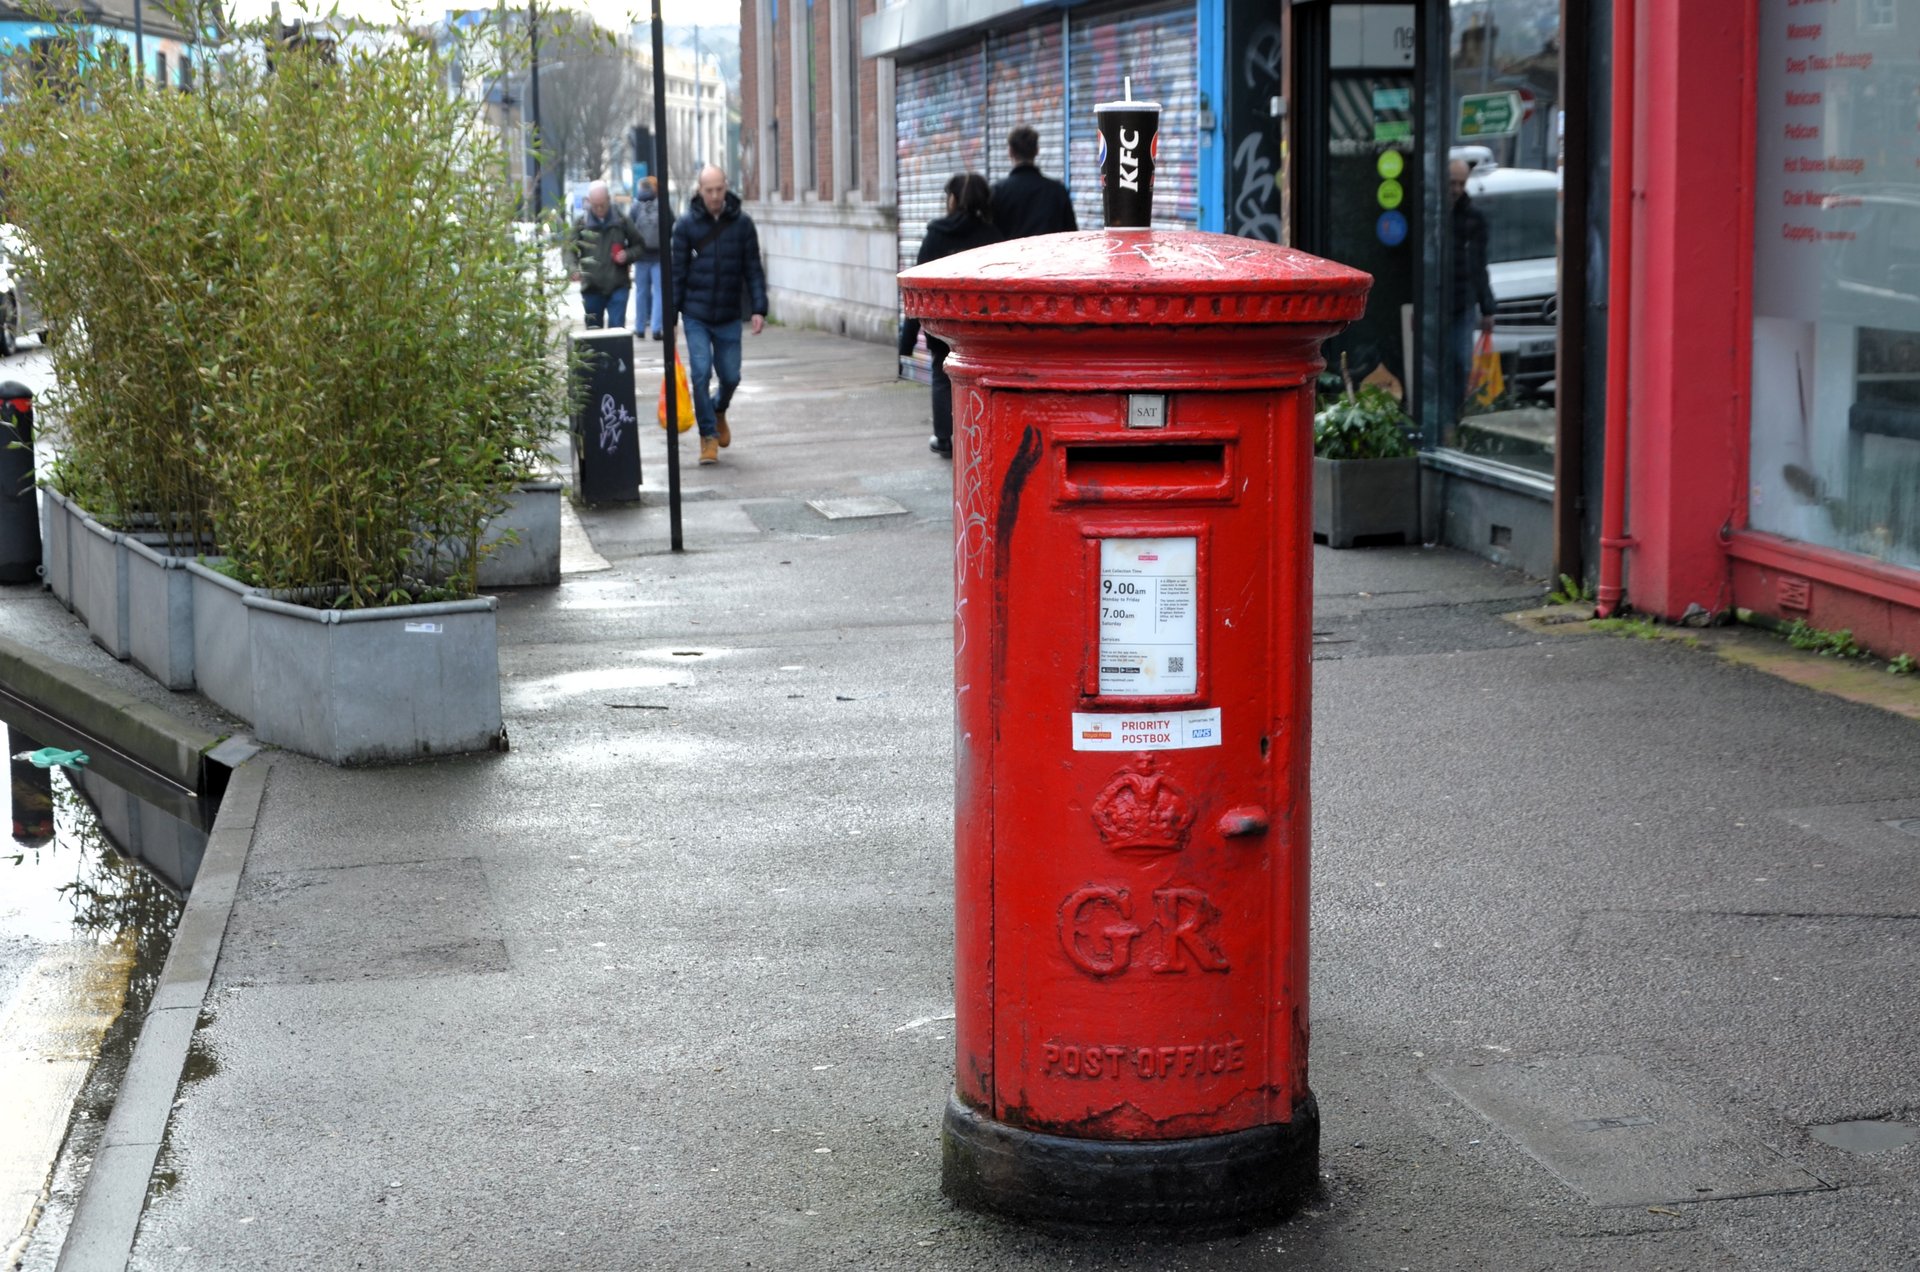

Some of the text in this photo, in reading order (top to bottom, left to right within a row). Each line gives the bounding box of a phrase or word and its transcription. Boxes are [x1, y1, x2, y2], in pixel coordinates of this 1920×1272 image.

[1119, 129, 1139, 192] KFC
[1137, 408, 1157, 416] SAT
[1103, 580, 1146, 594] 9.00am
[1102, 608, 1135, 618] 7.00am
[1121, 720, 1170, 730] PRIORITY
[1122, 733, 1171, 744] POSTBOX
[1193, 729, 1211, 738] NHS
[1043, 1040, 1246, 1079] POST OFFICE
